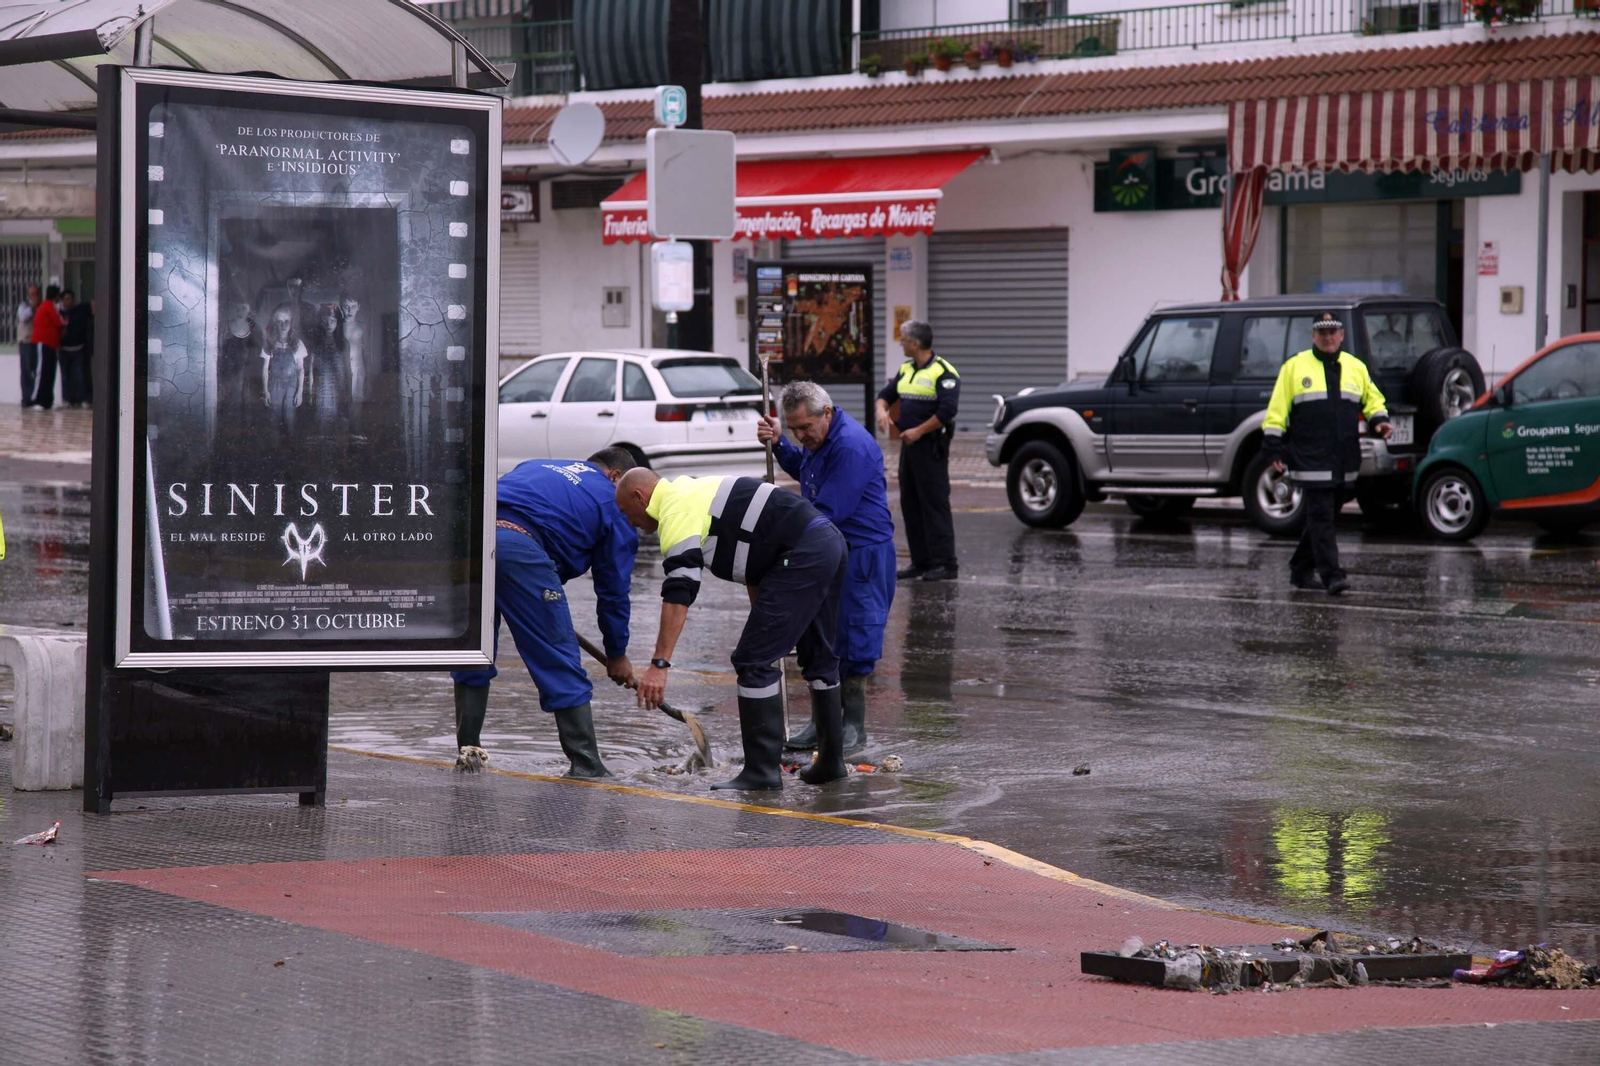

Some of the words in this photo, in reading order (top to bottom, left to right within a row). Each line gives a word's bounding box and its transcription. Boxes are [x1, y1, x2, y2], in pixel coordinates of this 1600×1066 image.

[237, 125, 253, 137] DE
[256, 127, 278, 138] LOS
[280, 128, 363, 143] PRODUCTORES
[365, 133, 381, 143] DE
[267, 162, 275, 172] E
[811, 206, 868, 235] Recargas
[869, 206, 886, 228] de
[888, 201, 937, 228] Móviles
[1517, 424, 1570, 439] Groupama
[167, 481, 435, 518] SINISTER
[170, 532, 187, 542] EL
[190, 532, 217, 542] MAL
[221, 532, 266, 542] RESIDE
[343, 532, 360, 542] AL
[363, 532, 398, 542] OTRO
[401, 532, 434, 542] LADO
[197, 614, 285, 632] ESTRENO
[292, 613, 309, 630] 31
[316, 612, 406, 630] OCTUBRE
